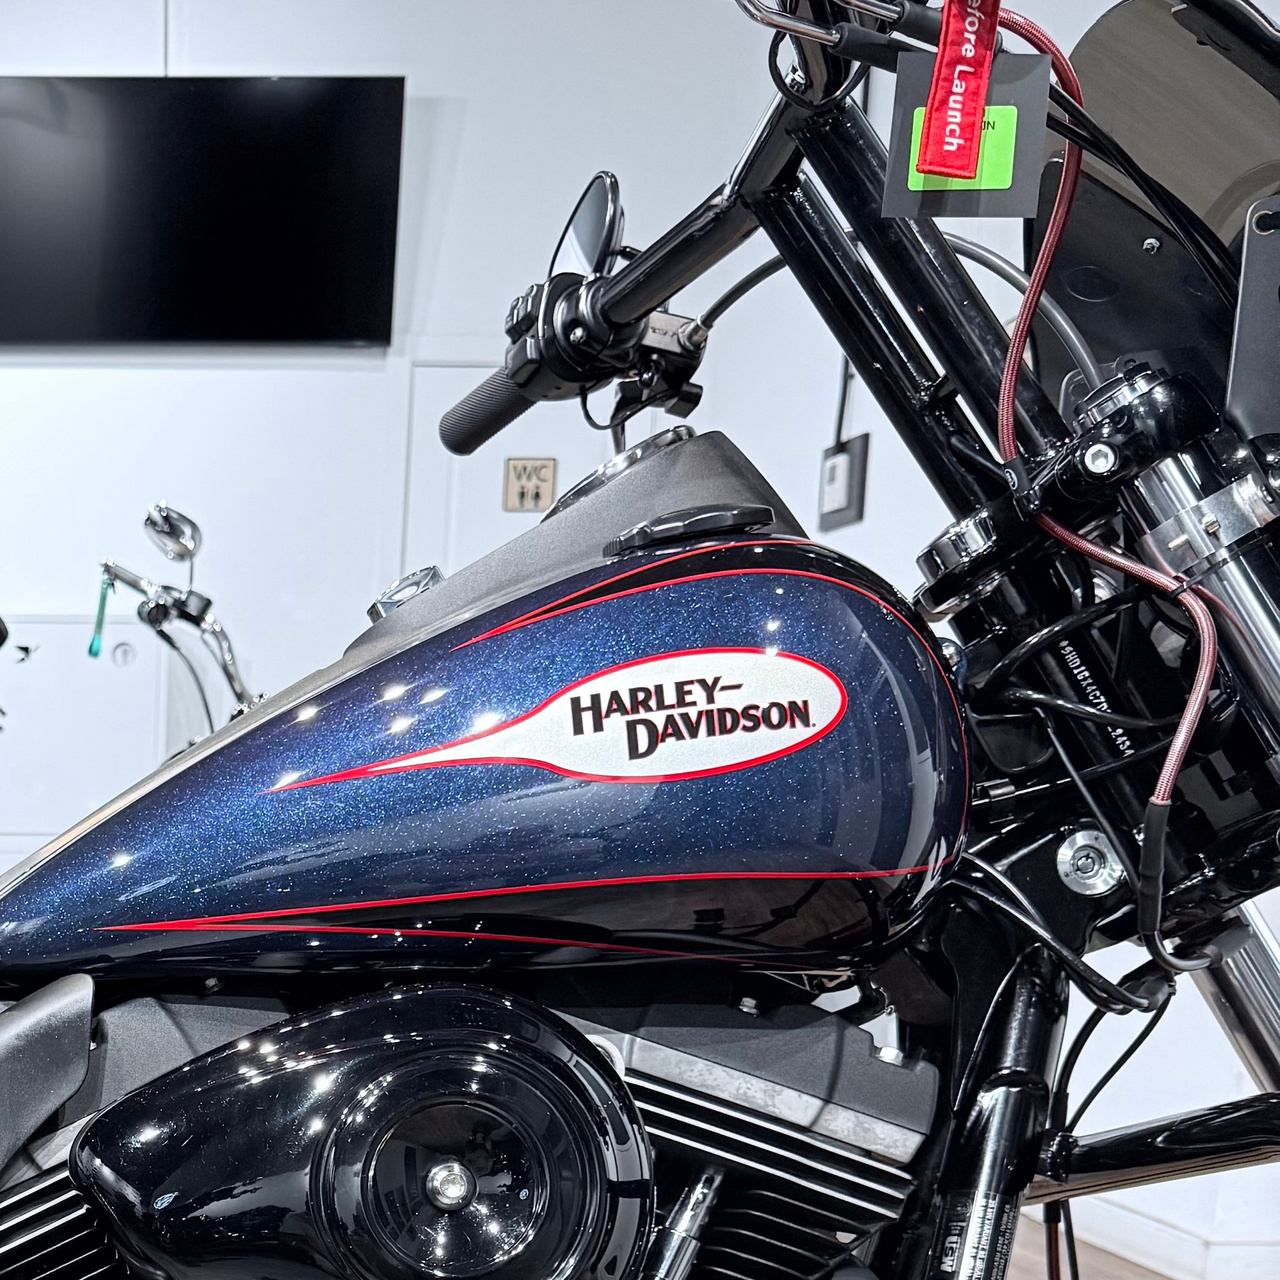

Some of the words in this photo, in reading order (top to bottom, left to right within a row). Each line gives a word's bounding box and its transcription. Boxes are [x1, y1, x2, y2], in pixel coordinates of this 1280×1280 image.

[943, 64, 975, 151] Launch
[512, 464, 550, 483] WC
[569, 675, 745, 737] HARLEY-
[625, 699, 812, 762] DAVIDSON
